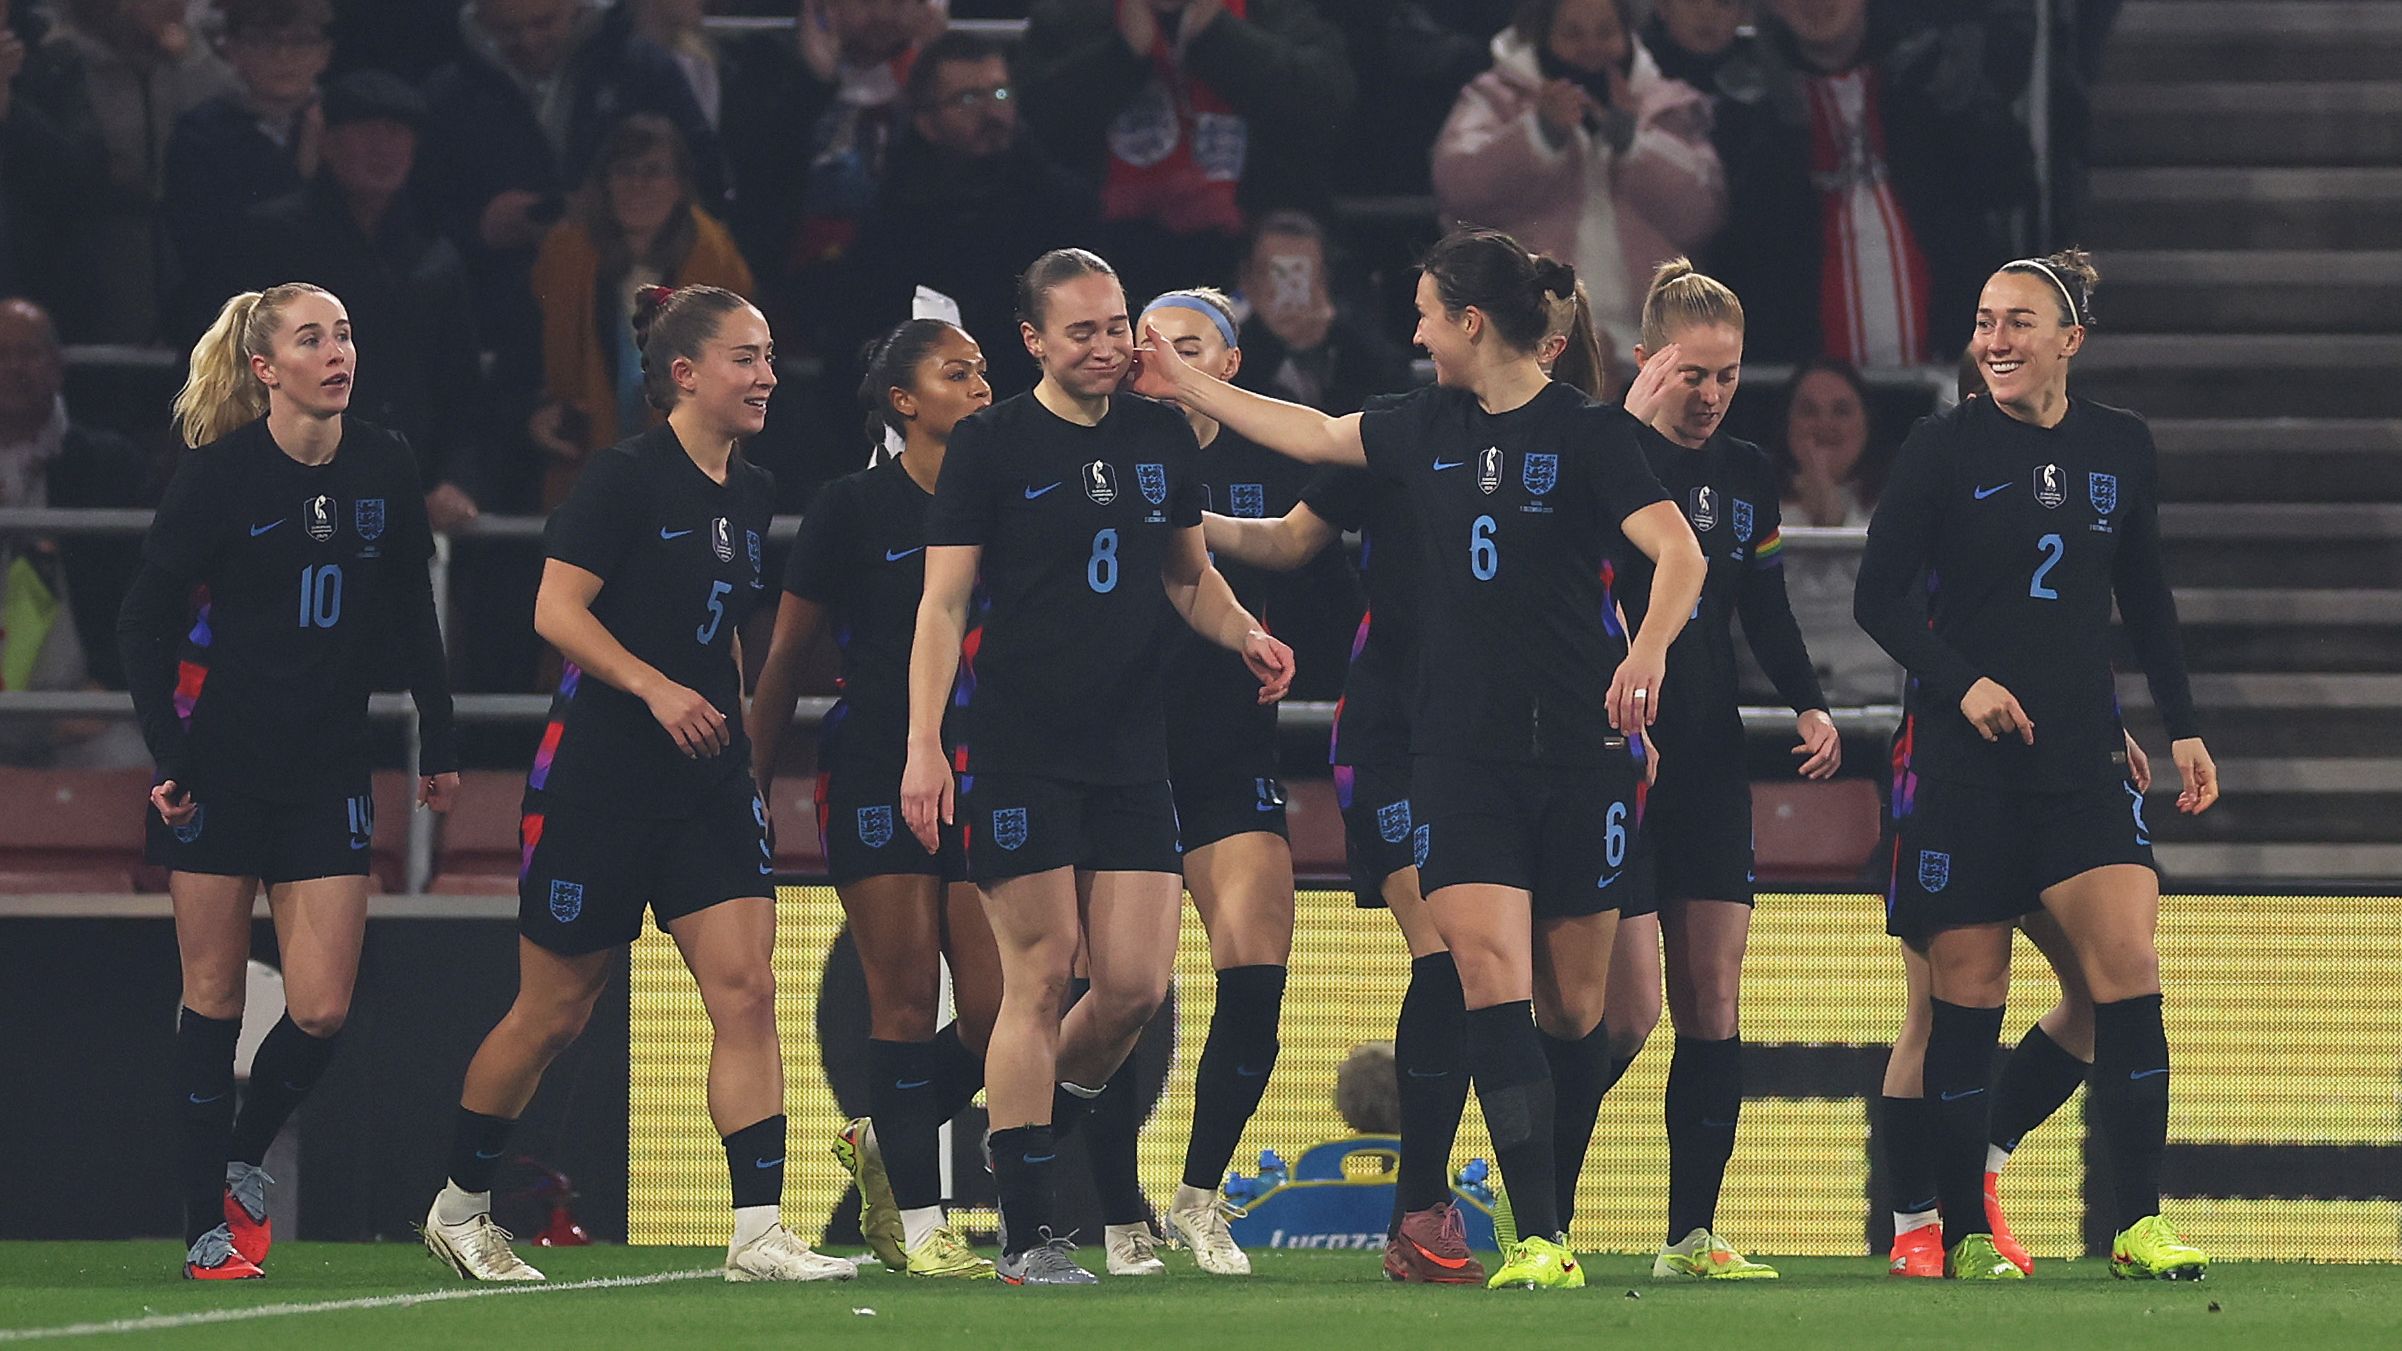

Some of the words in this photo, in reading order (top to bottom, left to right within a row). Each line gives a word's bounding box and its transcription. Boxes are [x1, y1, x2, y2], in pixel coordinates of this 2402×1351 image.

[1087, 527, 1119, 594] 8
[1468, 514, 1498, 581] 6
[2029, 533, 2064, 600] 2
[298, 564, 343, 628] 10
[696, 580, 733, 645] 5
[1604, 801, 1627, 867] 6
